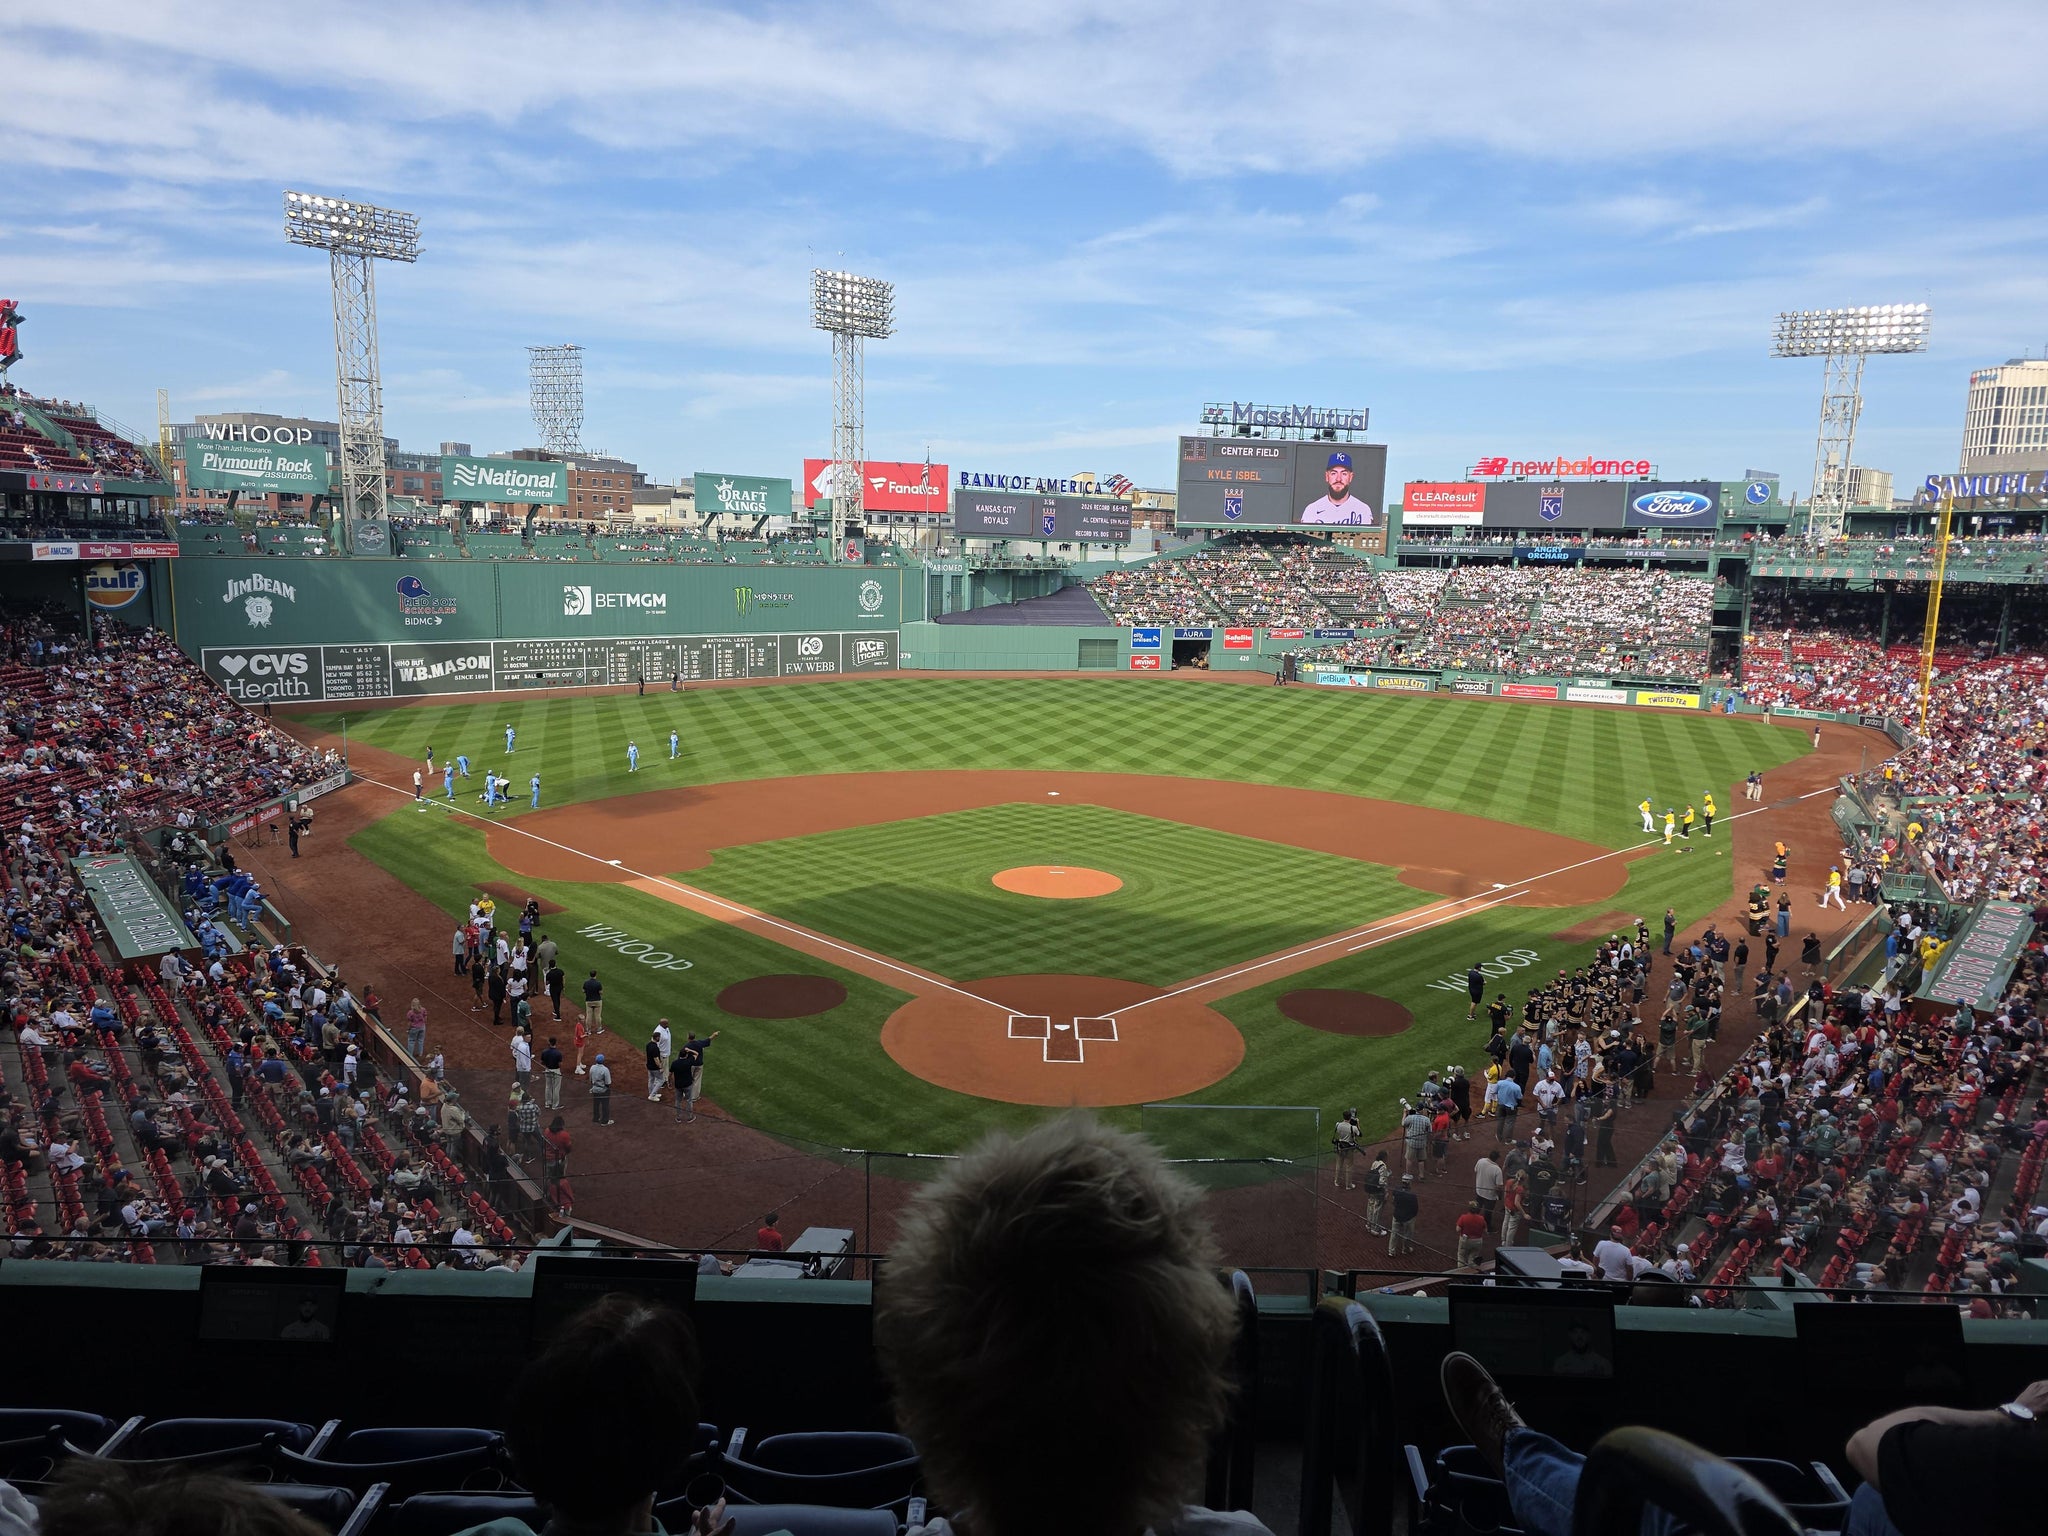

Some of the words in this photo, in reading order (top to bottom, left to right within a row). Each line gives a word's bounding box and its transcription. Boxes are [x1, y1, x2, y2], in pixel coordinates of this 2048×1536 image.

[1232, 401, 1369, 430] MassMutual
[204, 422, 312, 445] WHOOP
[197, 442, 214, 450] More
[215, 444, 230, 452] Than
[230, 445, 242, 453] Just
[1221, 446, 1254, 456] CENTER
[1256, 448, 1279, 457] FIELD
[202, 452, 273, 473] Plymouth
[276, 457, 313, 472] Rock
[1511, 461, 1554, 475] new
[1556, 456, 1650, 475] balance
[265, 470, 313, 480] assurance
[477, 467, 555, 488] National
[1208, 469, 1233, 480] KYLE
[1235, 470, 1262, 481] ISBEL
[961, 471, 1006, 489] BANK
[1012, 475, 1031, 490] OF
[1035, 477, 1102, 494] AMERICA
[1923, 473, 2034, 503] SAMUEL
[506, 488, 522, 496] Car
[524, 489, 553, 498] Rental
[718, 489, 768, 502] DRAFT
[1412, 492, 1477, 502] CLEAResult
[725, 501, 767, 512] KINGS
[975, 504, 1001, 513] KANSAS
[1002, 505, 1017, 514] CITY
[1543, 500, 1560, 516] KC
[1647, 495, 1696, 513] Ford
[984, 516, 1009, 525] ROYALS
[1527, 552, 1569, 560] ORCHARD
[86, 571, 139, 589] Gulf
[222, 578, 252, 604] JIM
[252, 573, 296, 603] BEAM
[404, 598, 429, 607] RED
[432, 598, 457, 607] SOX
[595, 593, 666, 607] BETMGM
[754, 593, 794, 601] MONSTER
[404, 607, 457, 615] SCHOLARS
[405, 617, 433, 625] BIDMC
[858, 641, 885, 653] ACE
[860, 651, 884, 661] TICKET
[249, 653, 308, 676] CVS
[393, 659, 410, 667] WHO
[411, 658, 424, 666] BUT
[806, 662, 835, 672] WEBB
[1320, 674, 1346, 683] jetBlue
[1378, 678, 1409, 687] GRANITE
[1410, 679, 1427, 689] CITY
[223, 676, 311, 699] Health
[1456, 683, 1487, 691] wasabi
[1675, 698, 1687, 706] TEA
[260, 806, 280, 822] Safelite
[96, 868, 160, 915] FENWAY
[1976, 912, 2022, 936] SOX
[123, 913, 184, 952] PARK
[576, 922, 694, 971] WHOOP
[1961, 932, 2010, 958] RED
